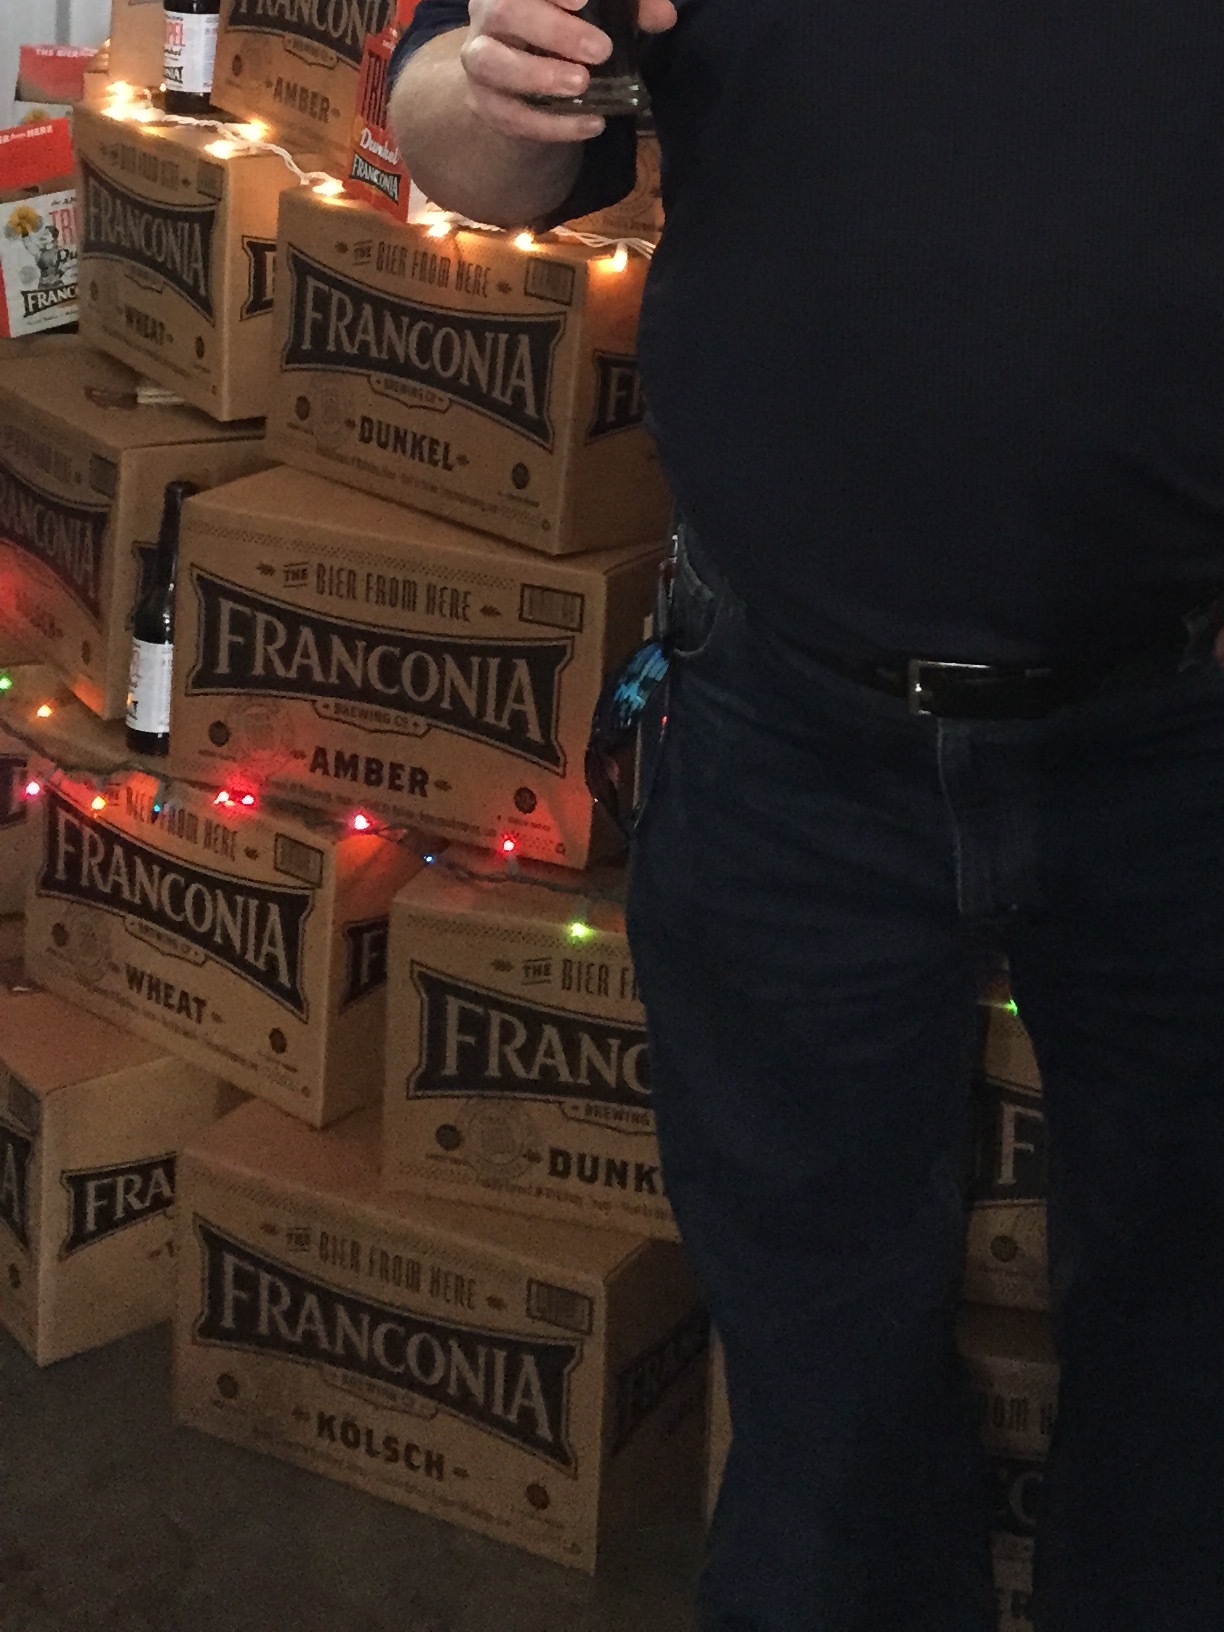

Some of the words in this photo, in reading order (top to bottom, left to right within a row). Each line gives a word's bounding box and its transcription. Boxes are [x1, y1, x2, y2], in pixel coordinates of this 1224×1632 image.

[272, 79, 331, 126] AMBER
[86, 184, 214, 320] FRANCONIA
[300, 278, 541, 420] FRANCONIA
[358, 415, 456, 473] DUNKEL
[282, 565, 310, 585] THE
[315, 562, 359, 600] BIER
[364, 574, 417, 612] FROM
[425, 586, 474, 622] HERE
[212, 596, 544, 745] FRANCONIA
[309, 746, 430, 798] AMBER
[53, 804, 296, 992] FRANCONIA
[125, 964, 209, 1028] WHEAT
[220, 1251, 554, 1445] FRANCONIA
